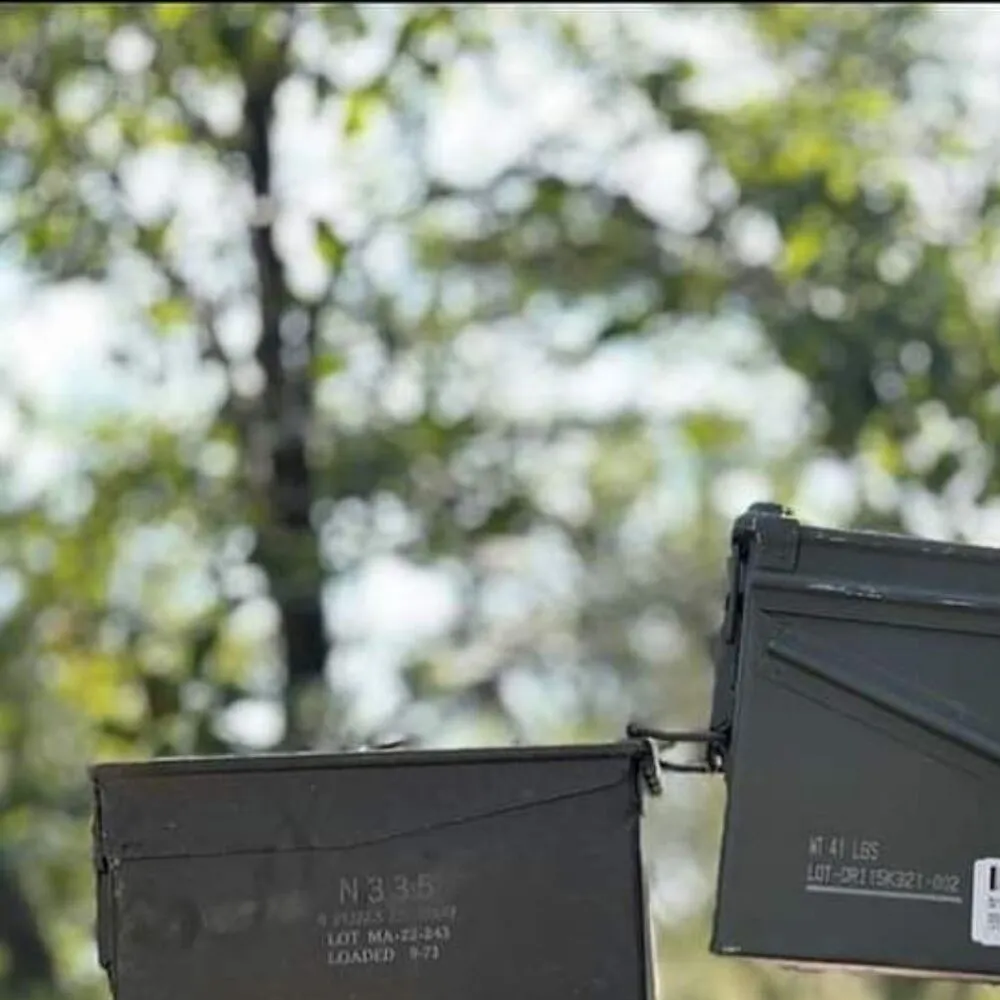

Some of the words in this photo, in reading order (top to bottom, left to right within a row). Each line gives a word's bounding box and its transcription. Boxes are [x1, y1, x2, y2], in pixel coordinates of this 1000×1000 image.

[852, 836, 880, 860] LBS
[327, 930, 358, 946] LOT
[327, 947, 396, 964] LOADED
